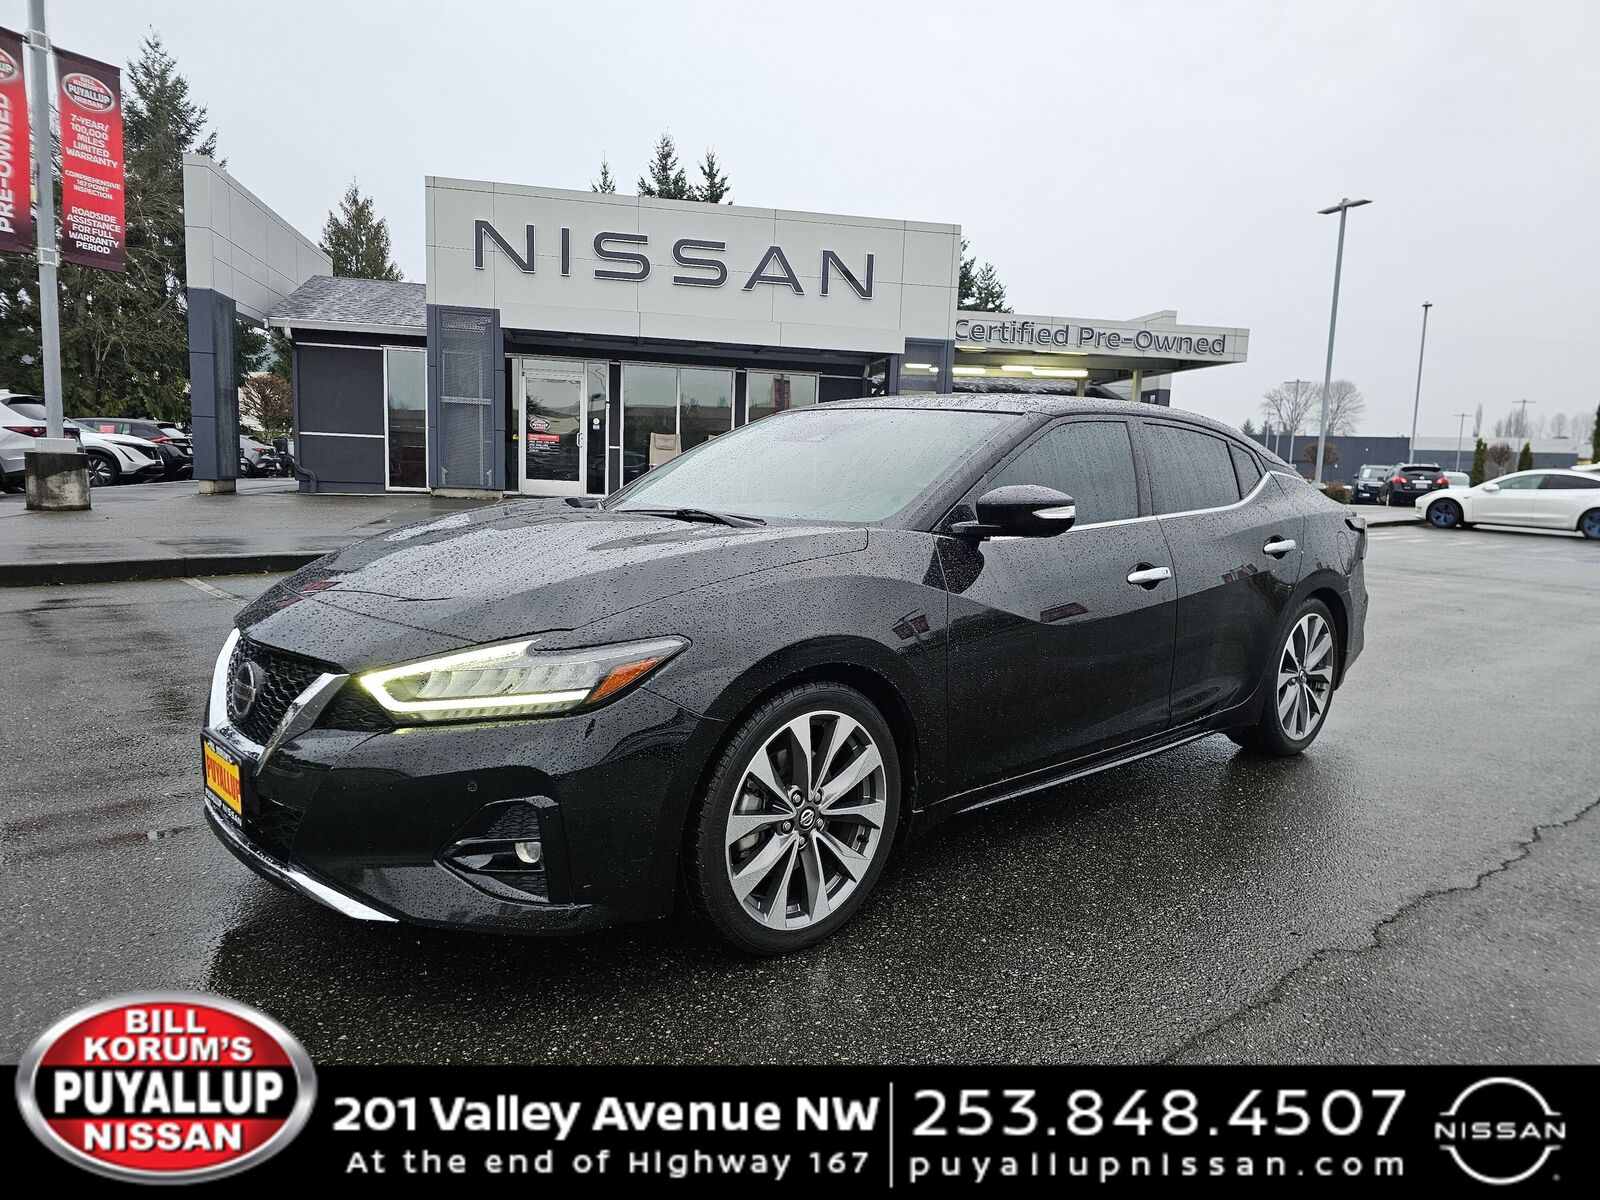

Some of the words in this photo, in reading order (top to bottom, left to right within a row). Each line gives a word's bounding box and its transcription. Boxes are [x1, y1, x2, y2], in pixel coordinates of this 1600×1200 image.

[68, 83, 111, 104] PUYALLUP
[70, 113, 109, 132] 7-YEAR/
[70, 122, 109, 140] 100,000
[73, 140, 110, 158] LIMITED
[77, 133, 106, 148] MILES
[65, 147, 118, 169] WARRANTY
[65, 169, 121, 190] COMPREHENSIVE
[88, 182, 109, 193] POINT
[73, 184, 113, 200] INSPECTION
[66, 213, 122, 233] ASSISTANCE
[71, 206, 117, 224] ROADSIDE
[68, 230, 120, 249] WARRANTY
[72, 223, 91, 235] FOR
[91, 227, 115, 240] FULL
[76, 240, 110, 255] PERIOD
[474, 219, 875, 300] NISSAN
[955, 319, 1070, 346] Certified
[1077, 326, 1226, 355] Pre-Owned
[206, 754, 241, 803] PUYALLUP
